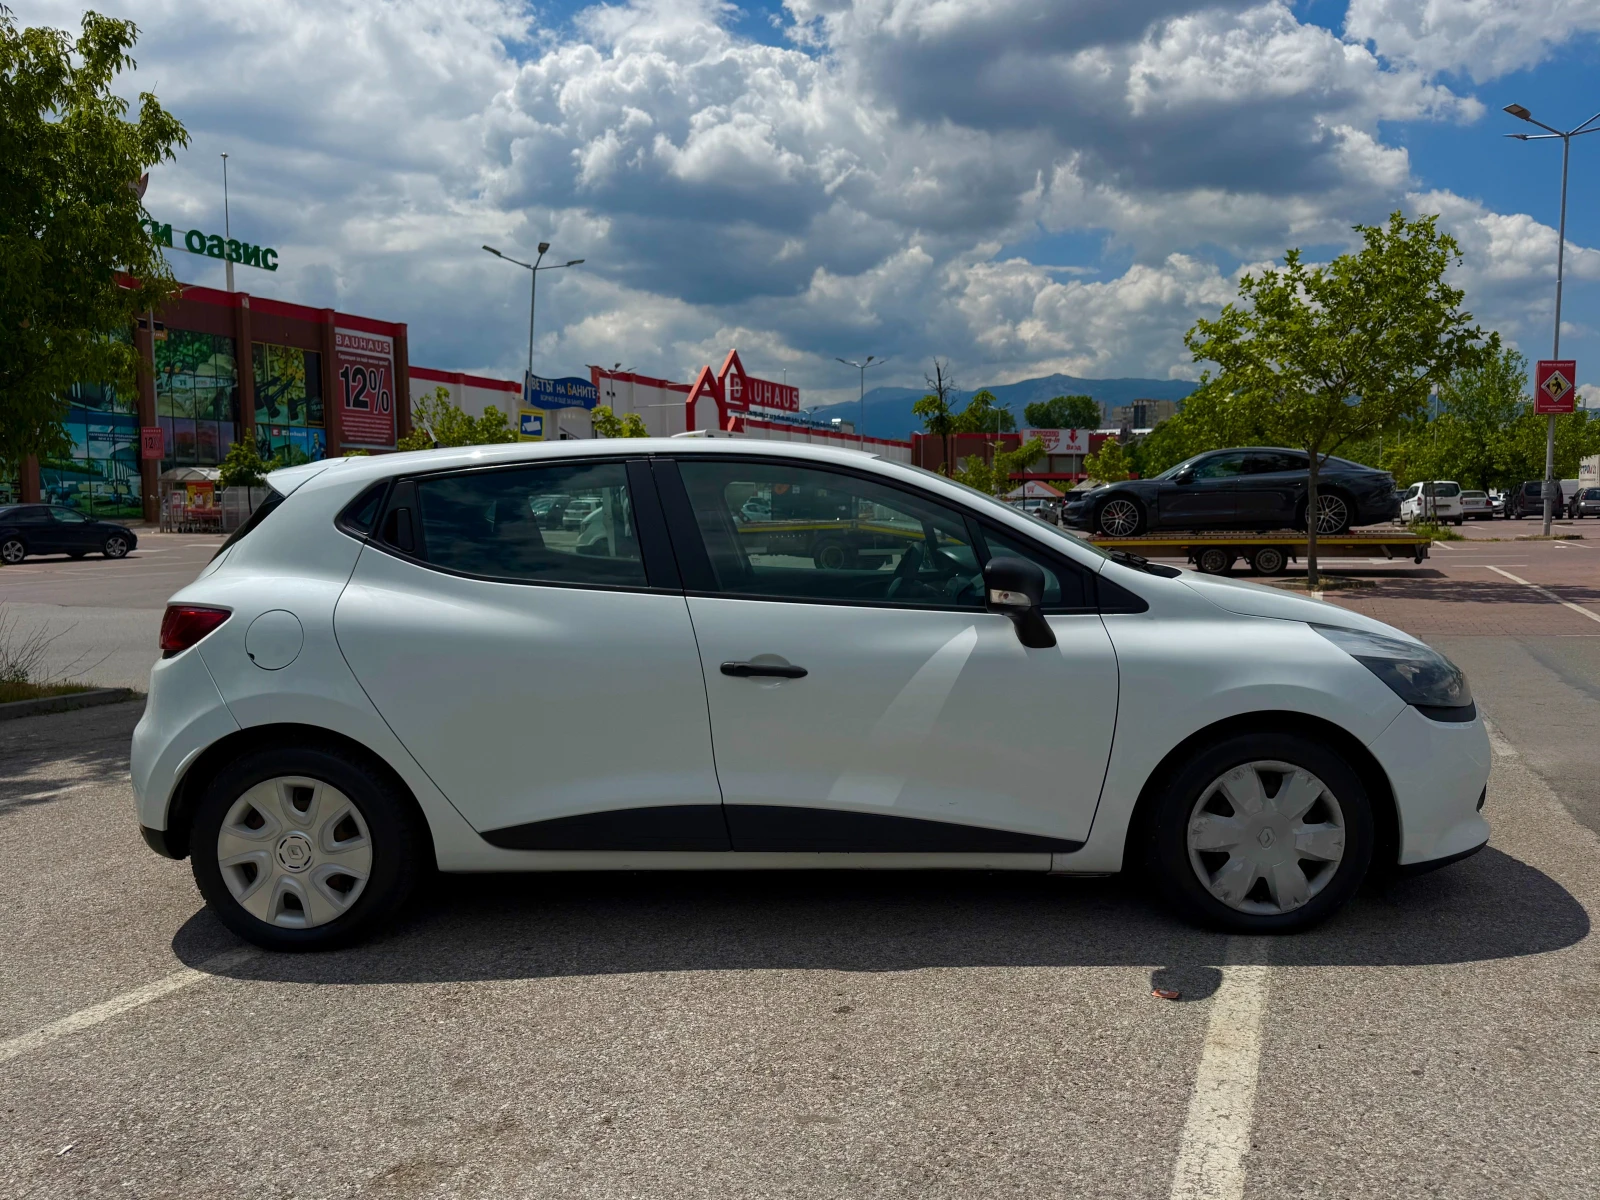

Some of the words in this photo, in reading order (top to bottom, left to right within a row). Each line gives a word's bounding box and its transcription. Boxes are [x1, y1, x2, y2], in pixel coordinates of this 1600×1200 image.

[185, 229, 279, 272] оазис
[335, 334, 390, 353] BAUHAUS
[339, 364, 390, 414] 12%
[556, 383, 566, 394] НА
[567, 382, 597, 399] БАНИТЕ
